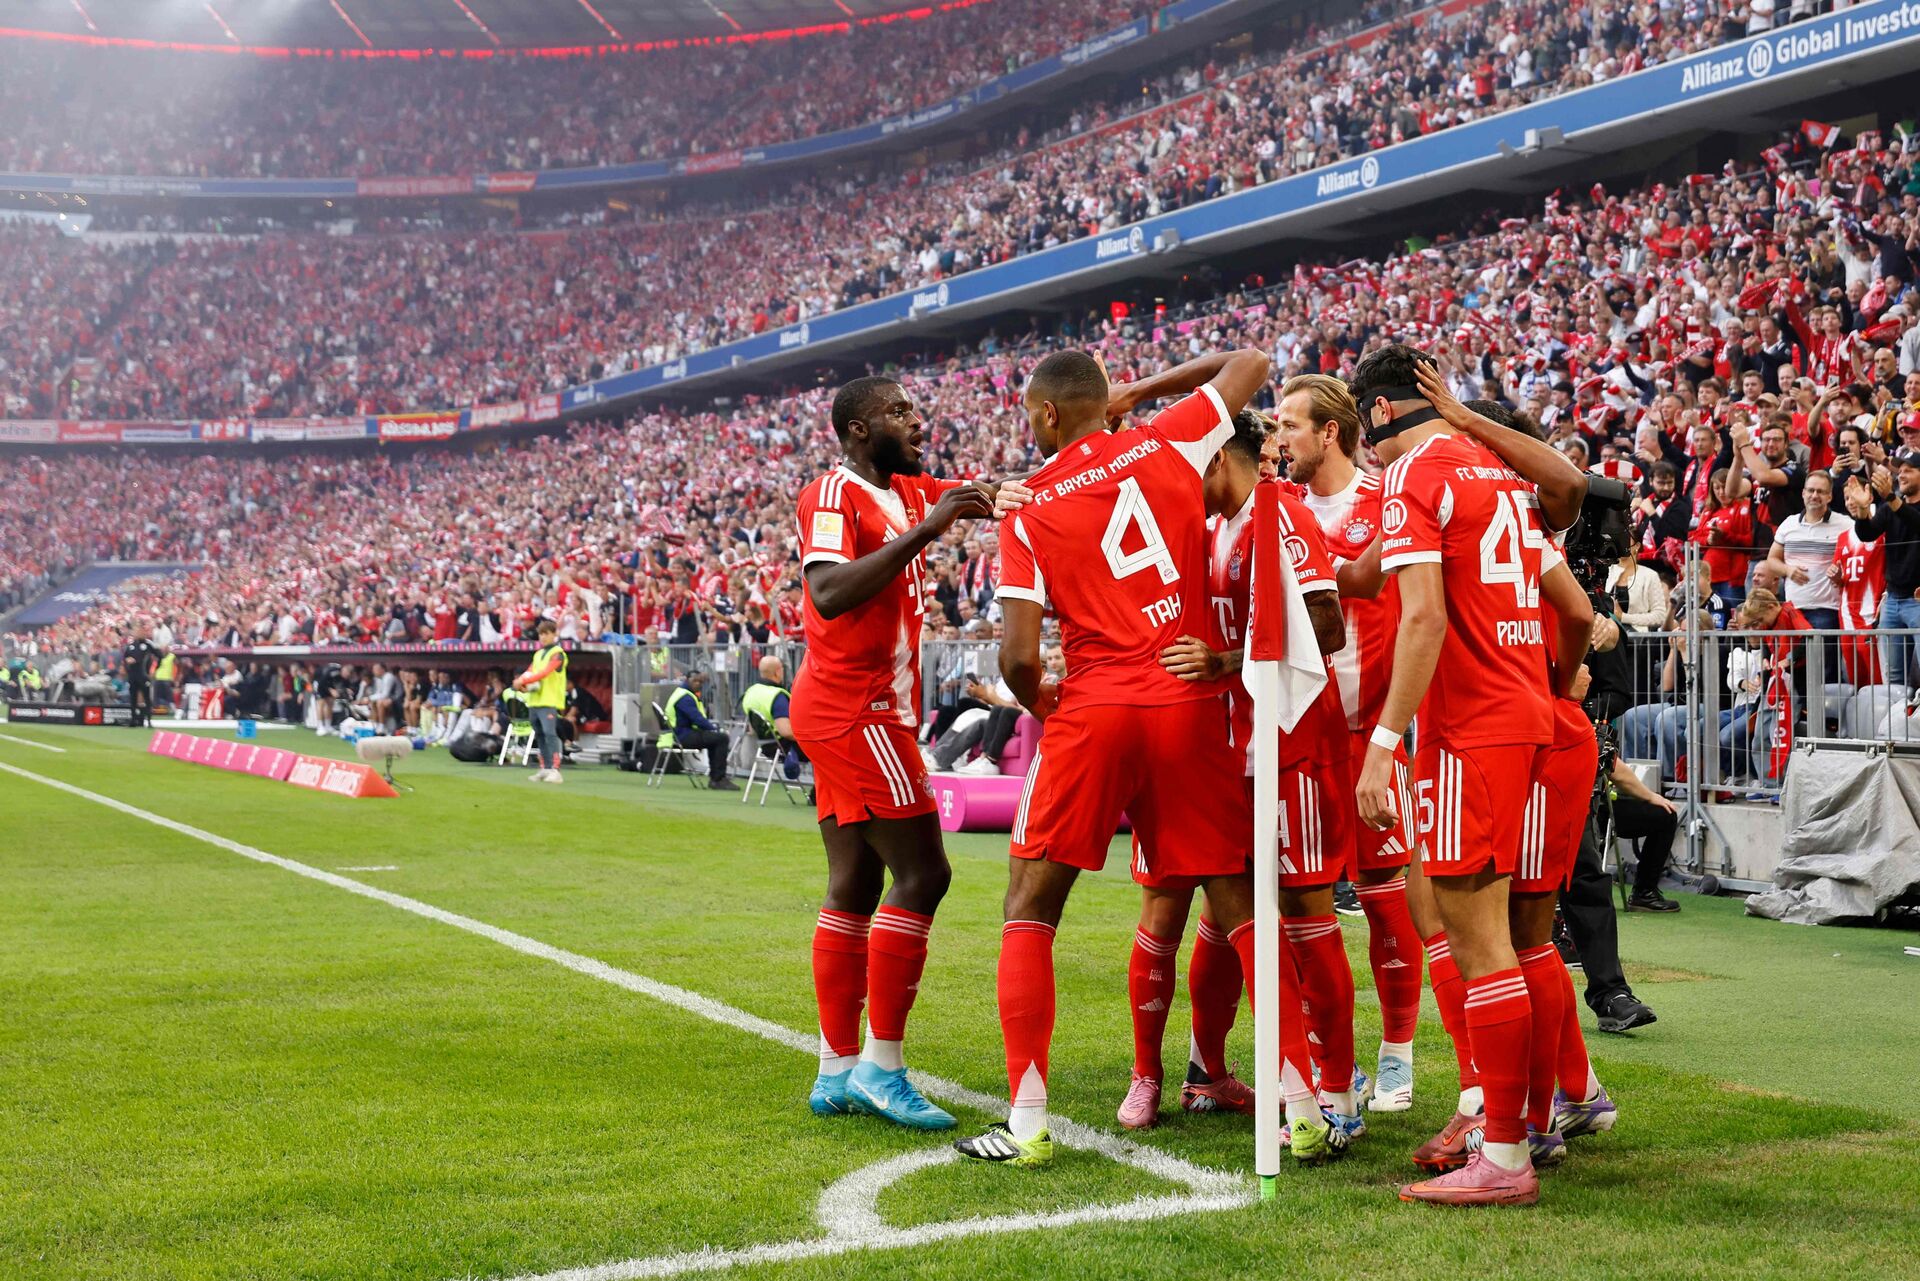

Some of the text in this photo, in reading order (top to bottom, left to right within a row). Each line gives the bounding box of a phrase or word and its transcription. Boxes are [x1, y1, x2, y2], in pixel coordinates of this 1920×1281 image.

[1681, 55, 1744, 93] Allianz
[1776, 22, 1840, 64] Global
[1317, 169, 1360, 197] Allianz
[1096, 236, 1129, 259] Allianz
[1034, 488, 1054, 506] FC
[1055, 466, 1108, 496] BAYERN
[1455, 466, 1474, 481] FC
[1100, 475, 1181, 586] 4
[1480, 489, 1544, 609] 45
[1846, 556, 1864, 582] T
[1141, 592, 1181, 628] TAH
[1414, 779, 1434, 834] 5
